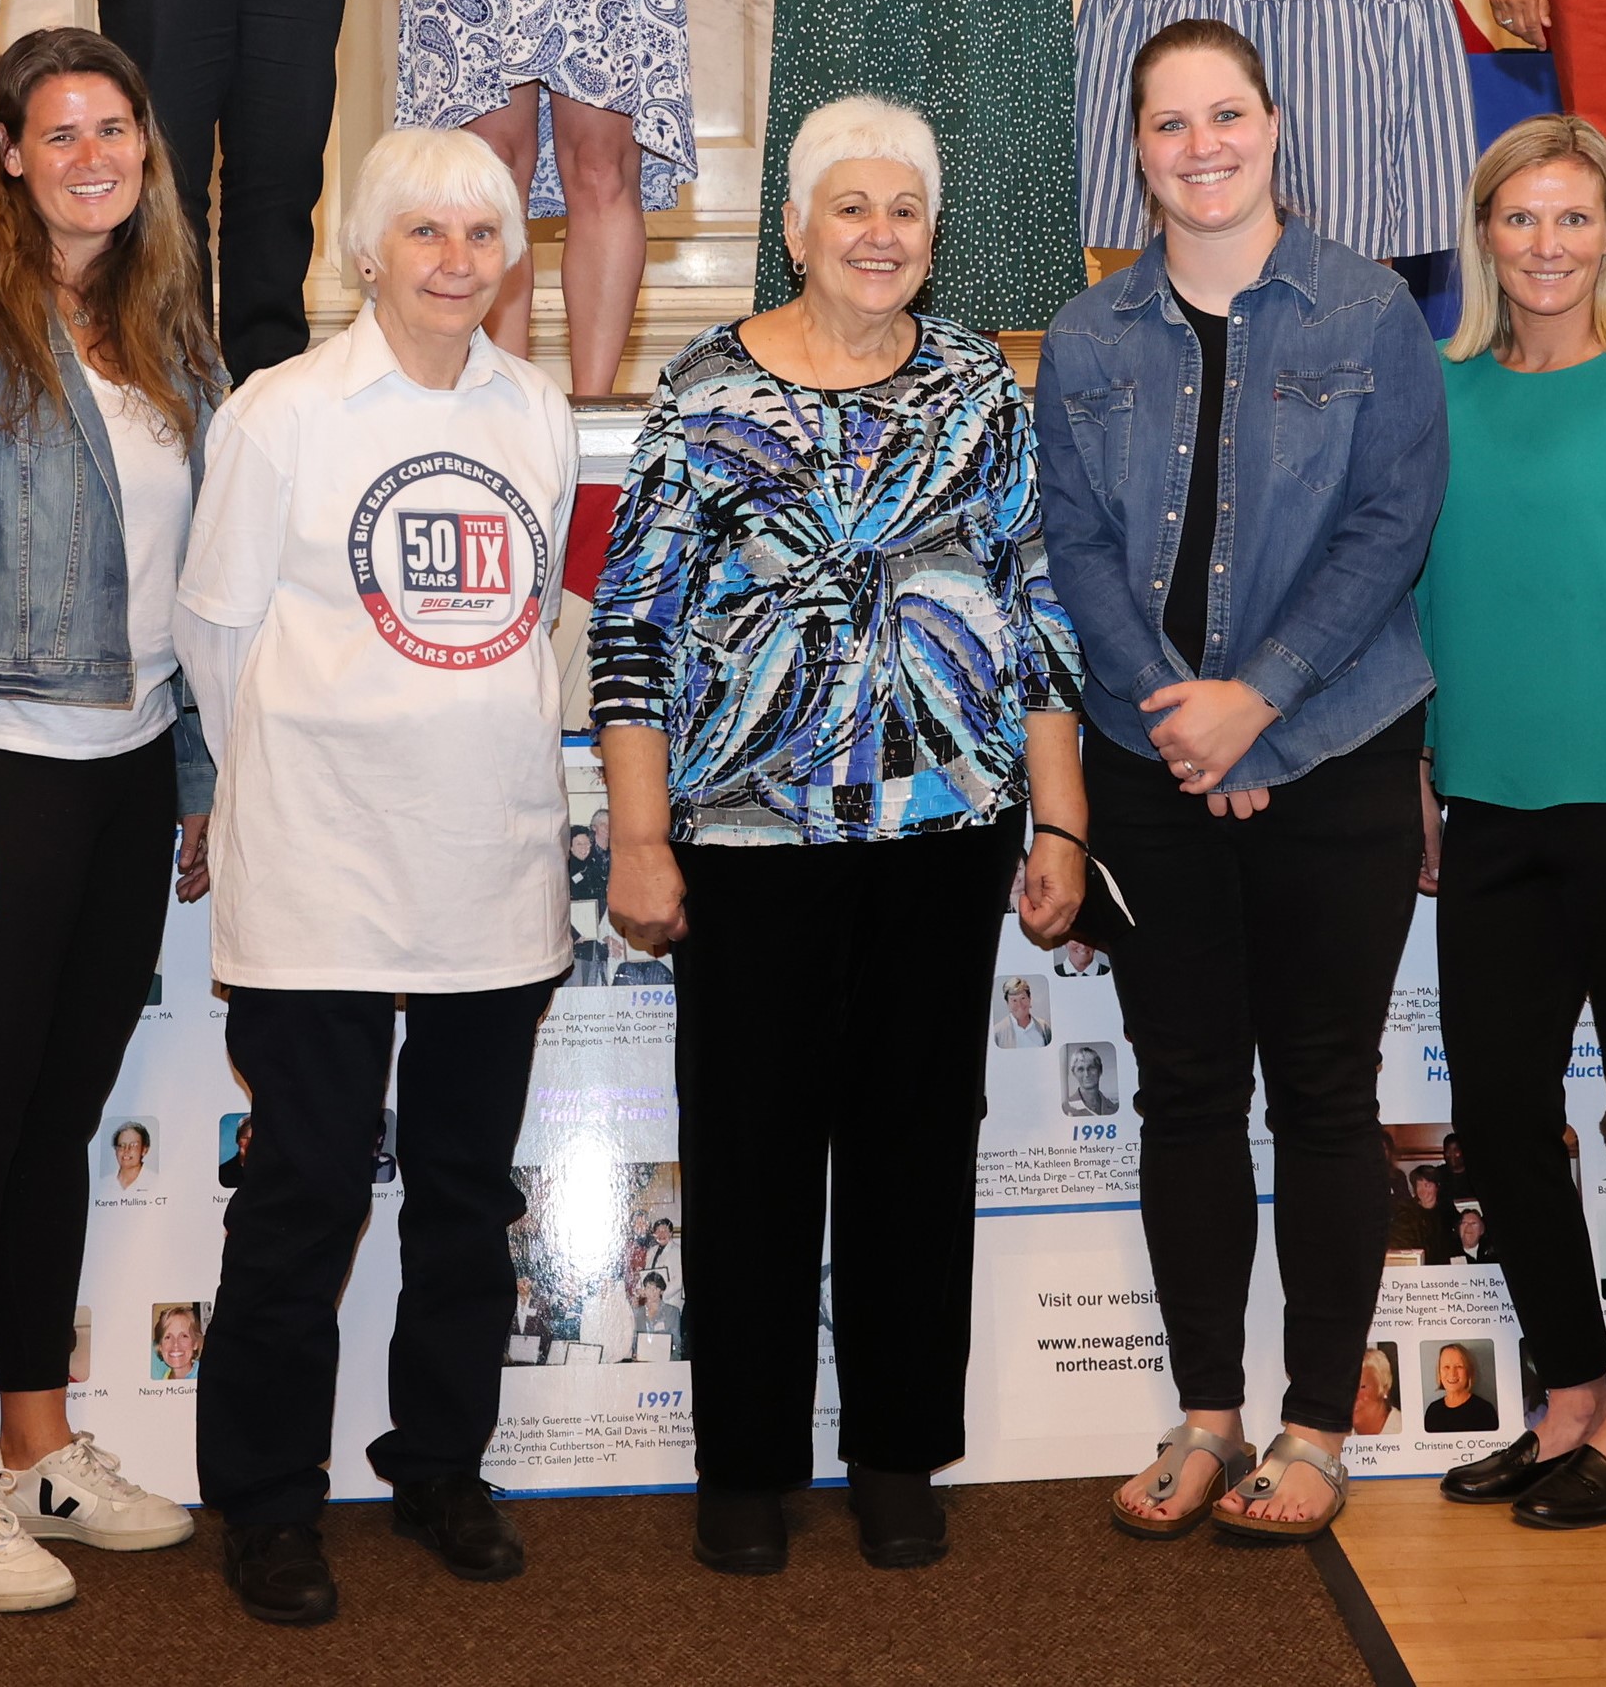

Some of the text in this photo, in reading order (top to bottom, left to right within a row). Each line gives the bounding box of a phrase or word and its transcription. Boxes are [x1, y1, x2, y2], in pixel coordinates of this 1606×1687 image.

[354, 457, 545, 588] THE BIG EAST CONFERENCE CELEBRATES
[404, 519, 503, 571] 50 TITLE
[408, 535, 506, 589] YEARS IX
[380, 612, 531, 665] 50 YEARS OF TITLE IX
[631, 990, 675, 1006] 1996
[563, 1010, 674, 1022] Carpenter Christine
[1072, 1124, 1117, 1141] 1998
[1048, 1145, 1114, 1155] Bonnie Maskery
[1020, 1184, 1095, 1197] Margaret Delaney
[95, 1197, 168, 1207] Karen Mullins CT
[1038, 1290, 1160, 1307] Visit our websit
[1382, 1291, 1498, 1304] Mary Bennett McGinn MA
[1056, 1356, 1164, 1372] northeast.org
[138, 1388, 164, 1397] Nancy
[638, 1391, 683, 1408] 1997
[520, 1413, 659, 1428] Sally Guerette Louise Wing
[514, 1438, 656, 1454] Cynthia Cuthbertson Faith
[1414, 1440, 1511, 1451] Christine O'Connor
